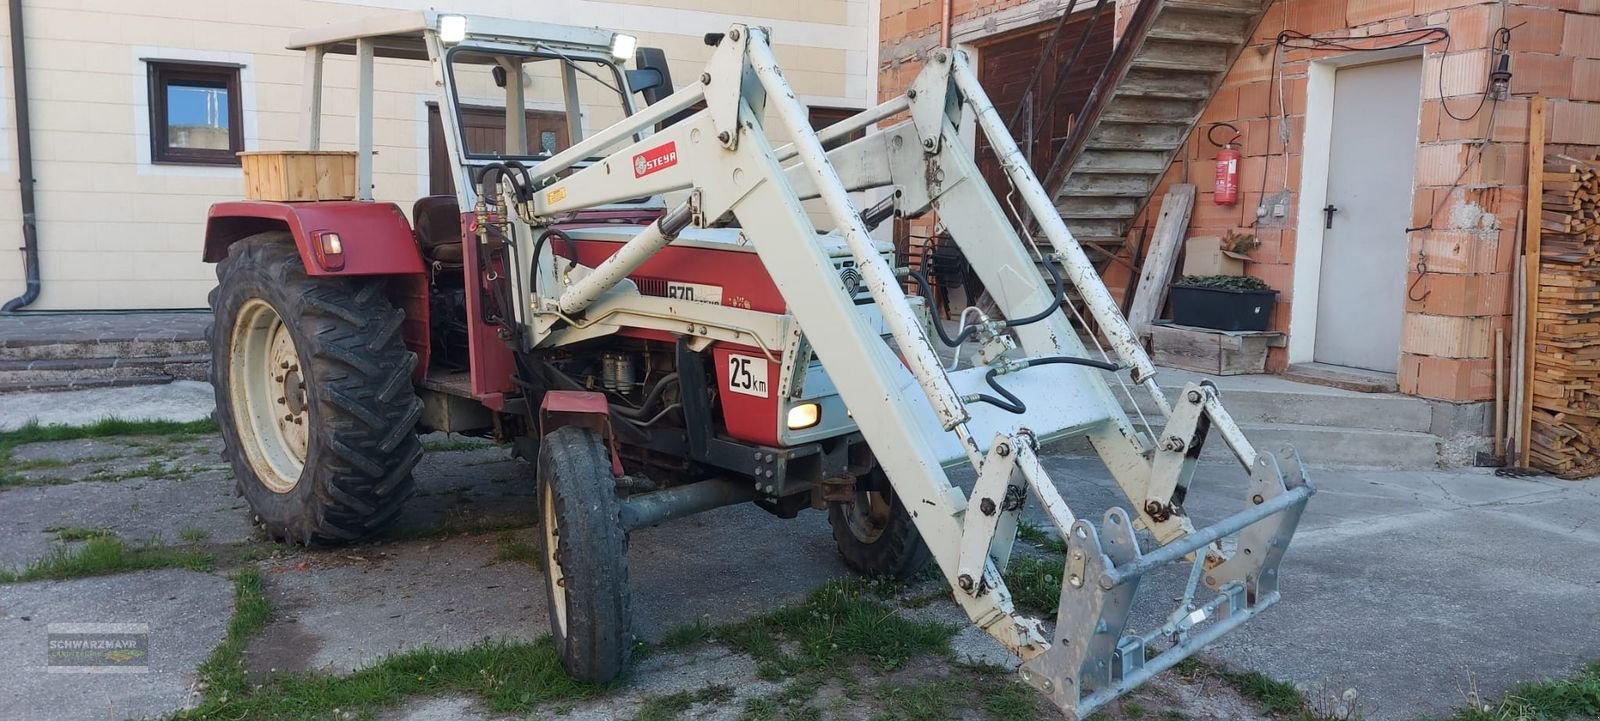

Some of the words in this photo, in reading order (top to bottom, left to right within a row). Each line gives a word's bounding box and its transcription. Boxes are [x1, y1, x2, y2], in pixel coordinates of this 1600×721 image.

[646, 151, 676, 170] STEYR
[730, 357, 752, 390] 25
[752, 375, 767, 393] km
